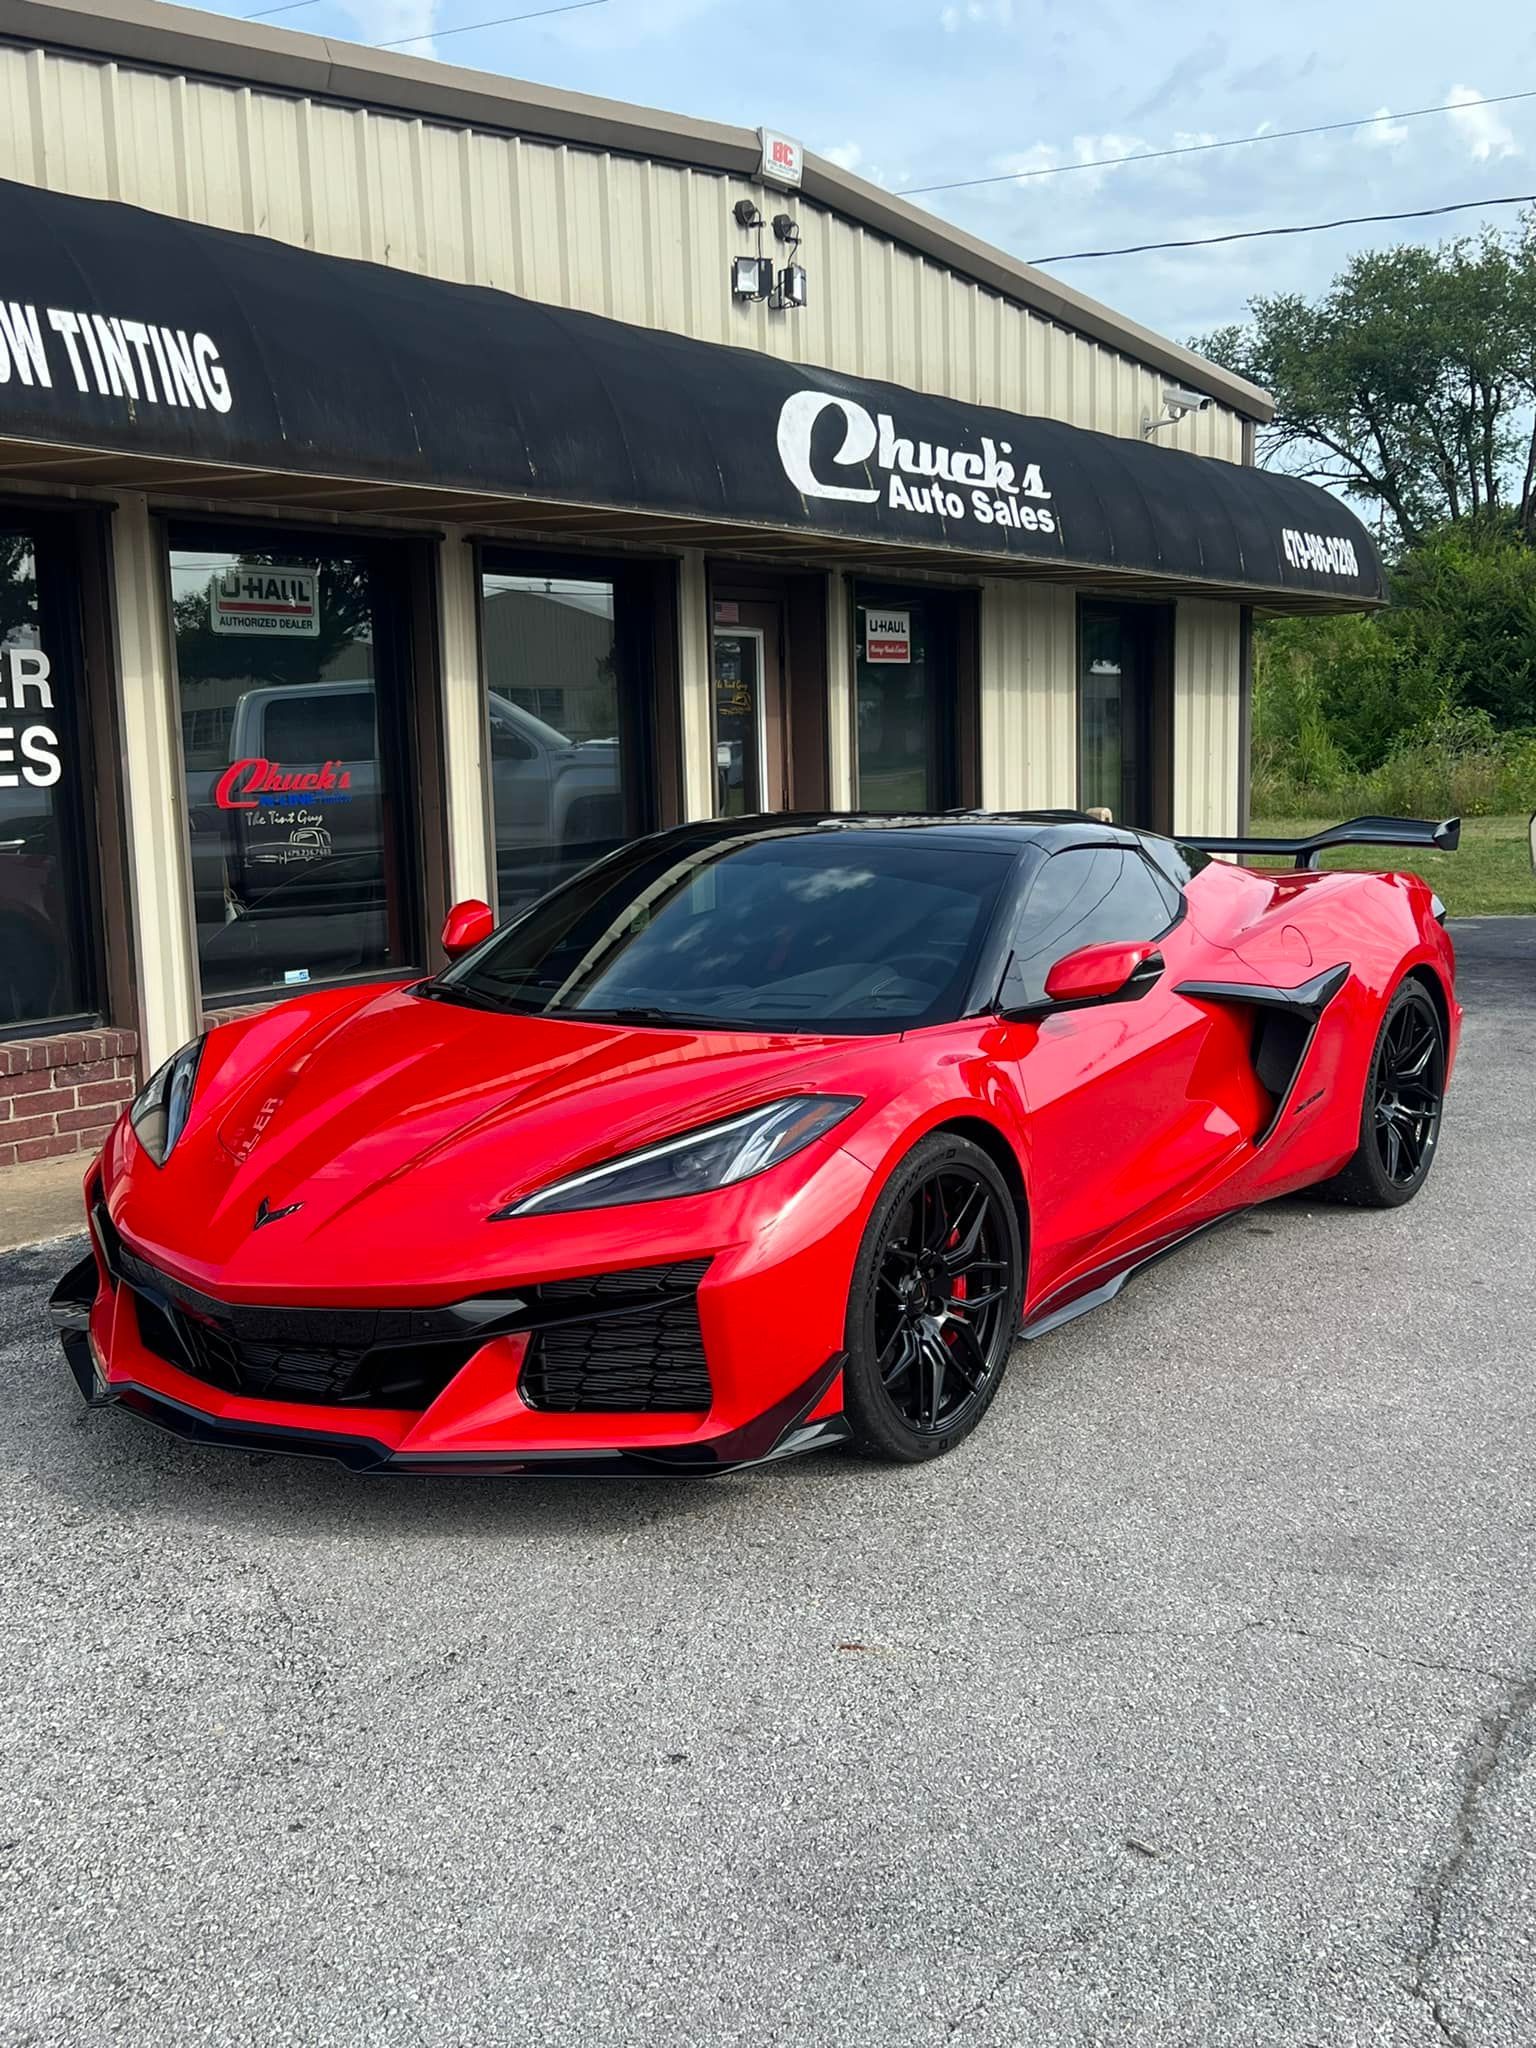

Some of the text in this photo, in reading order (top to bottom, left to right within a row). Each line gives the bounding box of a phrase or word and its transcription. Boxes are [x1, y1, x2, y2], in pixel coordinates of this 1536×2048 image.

[46, 308, 233, 414] TINTING
[776, 390, 1051, 503] Chuck's
[889, 474, 1055, 533] Auto Sales
[220, 576, 310, 602] U-HAUL
[219, 616, 313, 630] AUTHORIZED DEALER
[869, 619, 906, 633] U-HAUL
[215, 758, 352, 809] Chuck's
[245, 811, 266, 826] The
[297, 809, 323, 826] Guy
